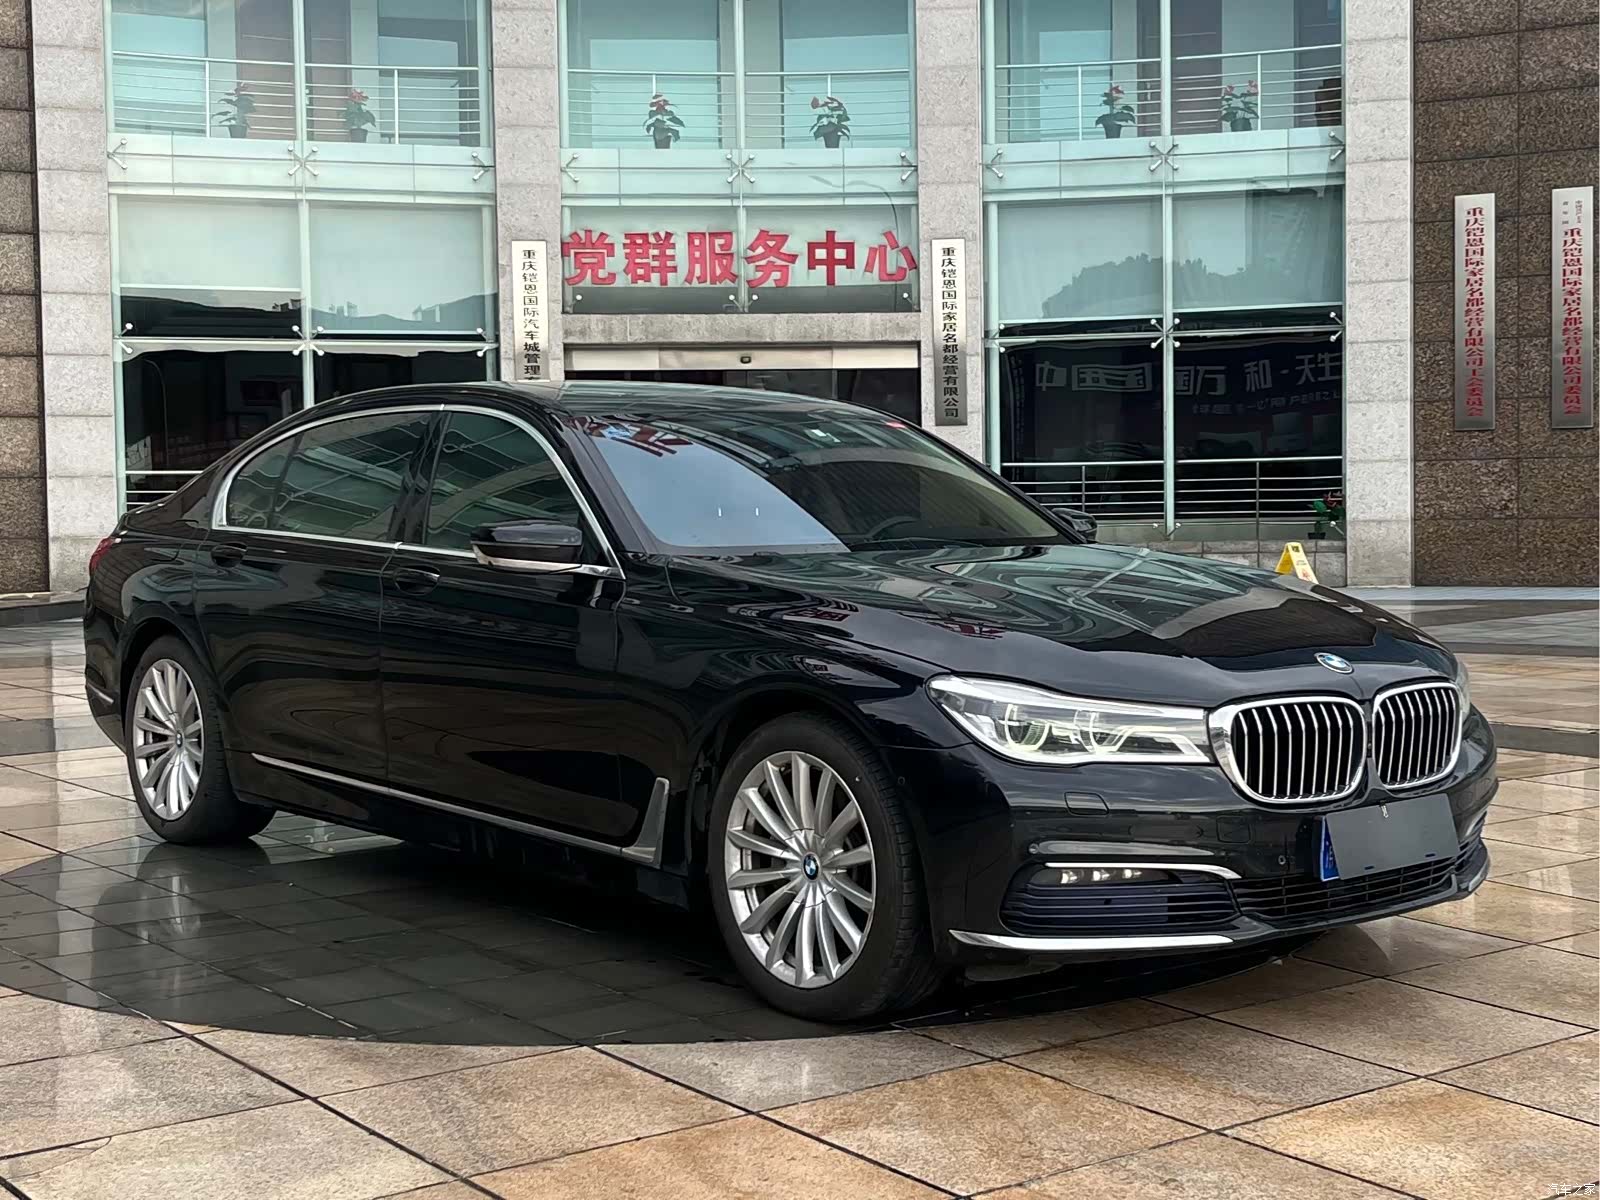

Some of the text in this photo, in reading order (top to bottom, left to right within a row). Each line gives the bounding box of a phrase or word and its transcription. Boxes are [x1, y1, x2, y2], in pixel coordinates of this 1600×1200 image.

[562, 229, 917, 287] 党群服务中心
[941, 247, 959, 418] 重庆铠恩国际家居名都经营有限公司
